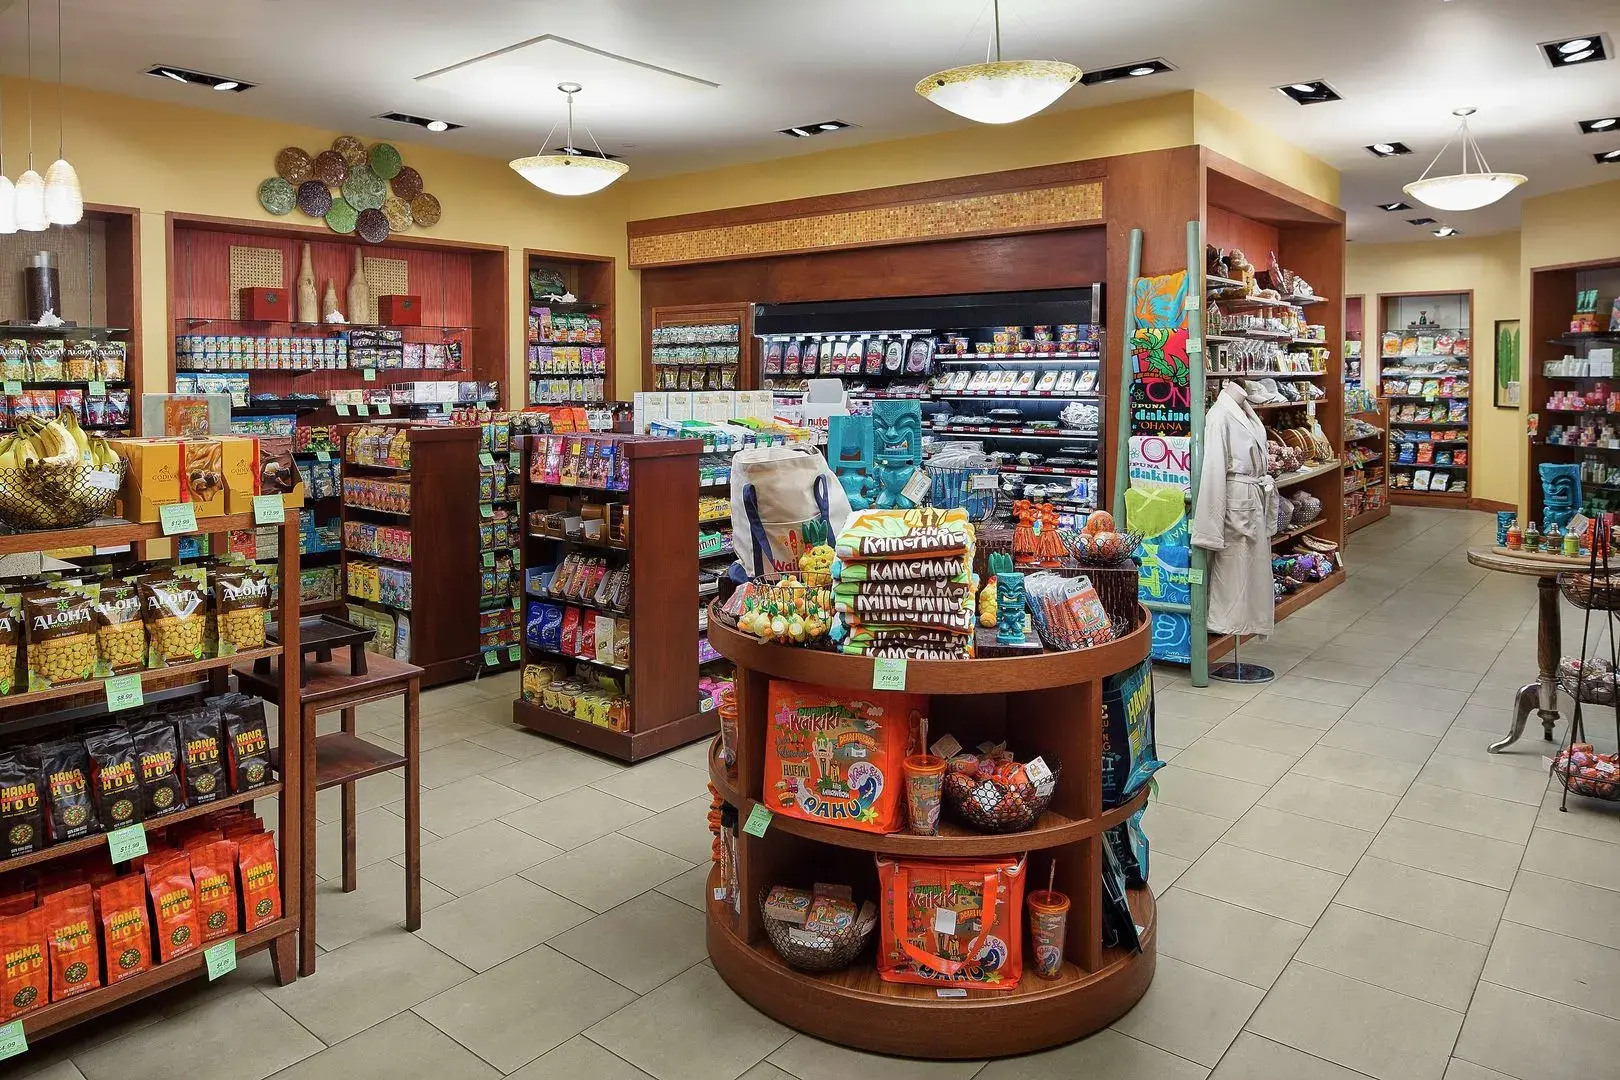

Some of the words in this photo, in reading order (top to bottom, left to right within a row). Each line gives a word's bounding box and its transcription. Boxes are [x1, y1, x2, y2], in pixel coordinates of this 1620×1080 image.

[808, 416, 829, 427] nute
[171, 519, 190, 527] $12.99
[223, 584, 268, 601] ALOHA
[33, 608, 92, 631] ALOHA
[117, 693, 133, 702] $8.99
[235, 729, 262, 743] HANA
[187, 737, 216, 751] HANA
[142, 751, 172, 766] HANA
[49, 768, 81, 784] HANA
[100, 761, 132, 777] HANA
[1, 782, 36, 798] HANA
[803, 796, 862, 819] OAHU
[120, 842, 140, 853] $11.99
[246, 862, 273, 877] HANA
[200, 873, 228, 888] HANA
[159, 887, 189, 905] HANA
[5, 943, 40, 963] HANA
